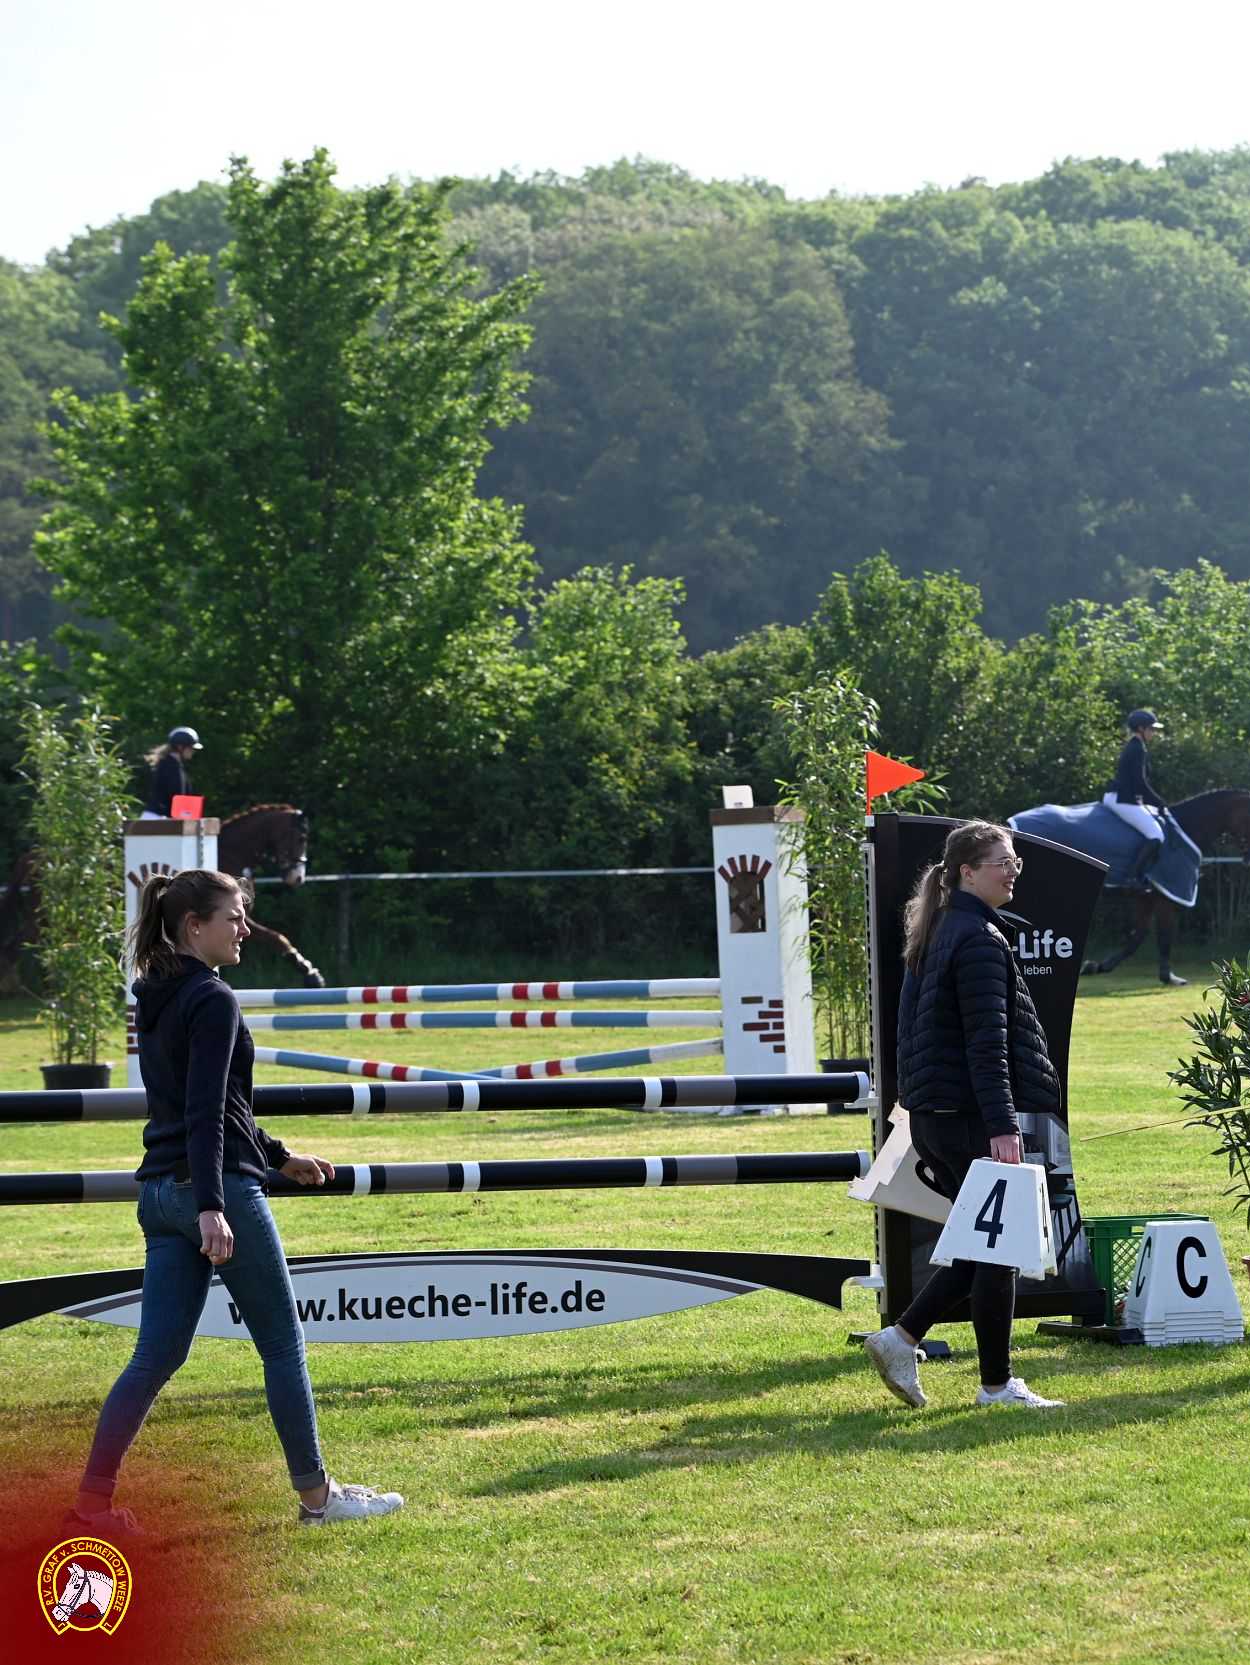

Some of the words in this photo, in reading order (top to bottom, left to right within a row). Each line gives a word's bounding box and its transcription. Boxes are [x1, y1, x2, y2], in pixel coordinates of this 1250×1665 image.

[1010, 929, 1073, 959] -Life
[1023, 965, 1053, 976] leben
[974, 1179, 1008, 1249] 4
[1176, 1236, 1209, 1299] C
[228, 1280, 606, 1325] w.kueche-life.de
